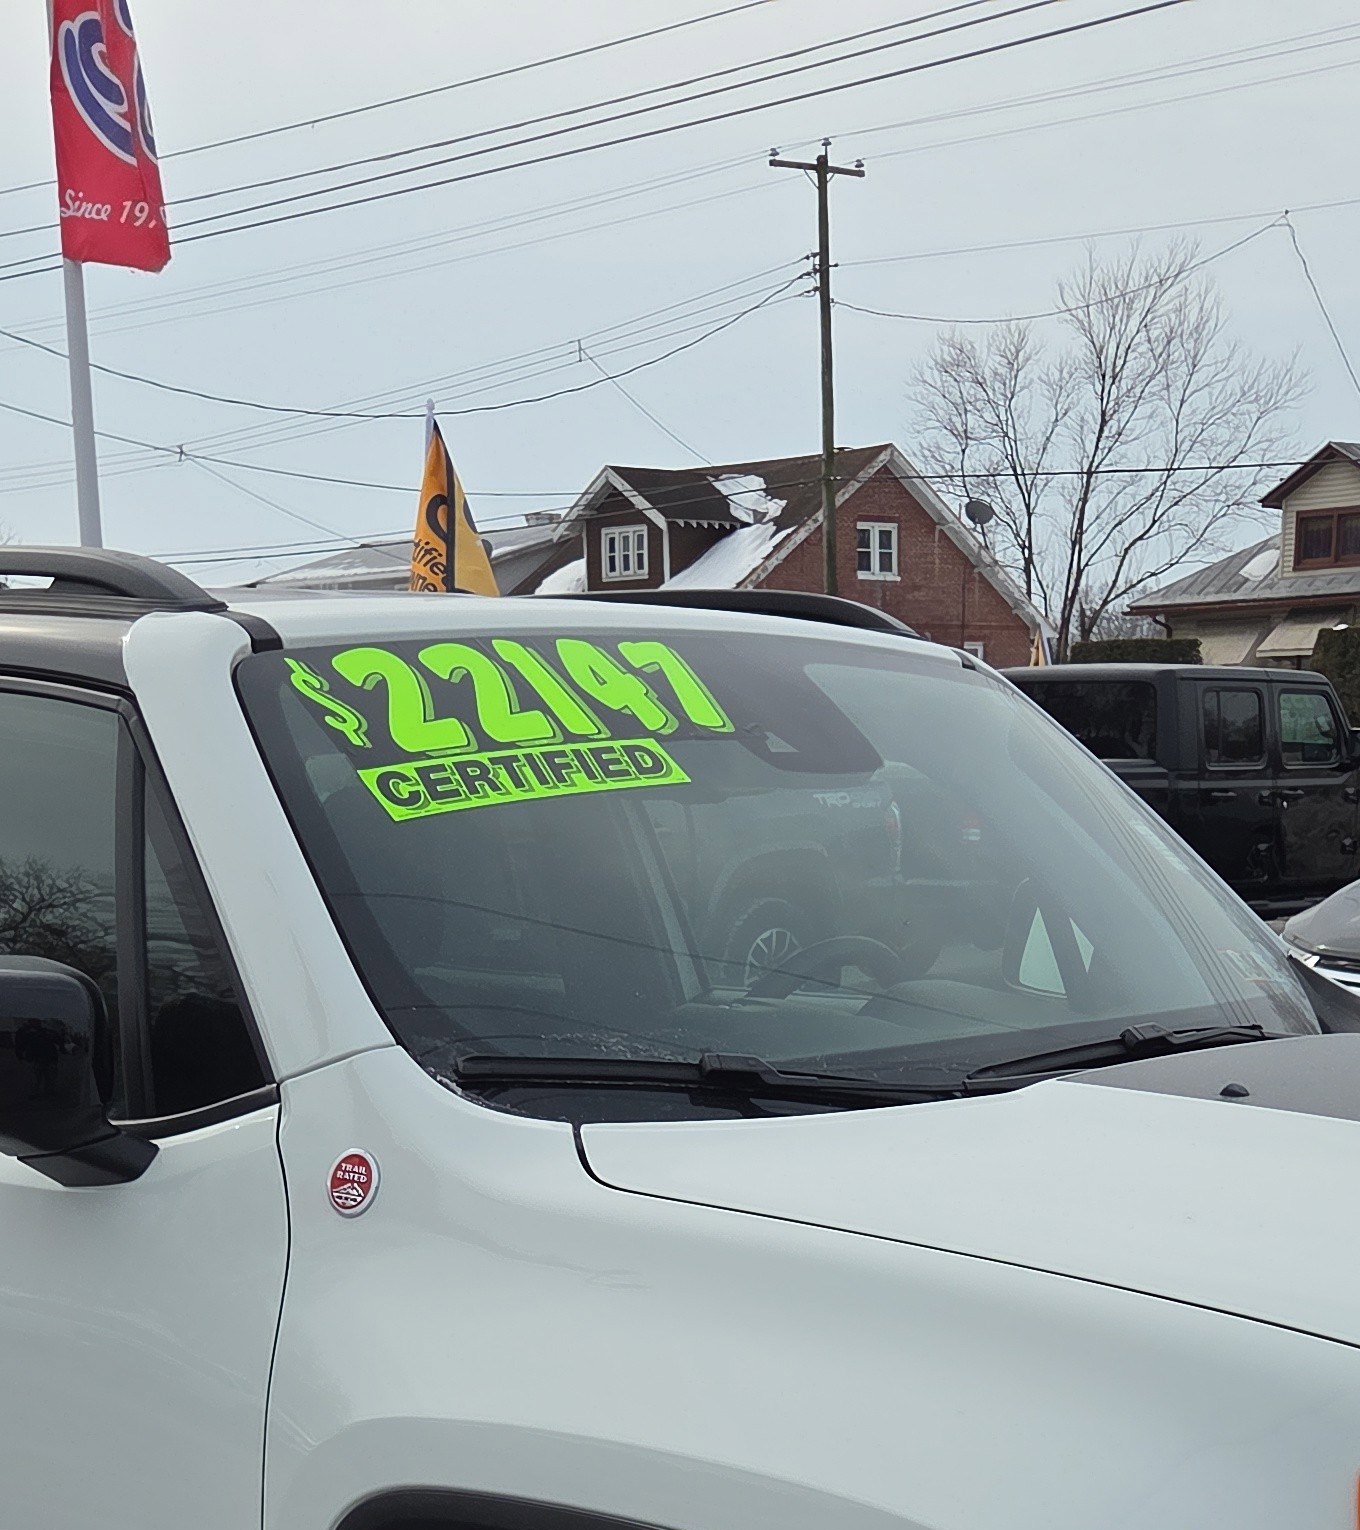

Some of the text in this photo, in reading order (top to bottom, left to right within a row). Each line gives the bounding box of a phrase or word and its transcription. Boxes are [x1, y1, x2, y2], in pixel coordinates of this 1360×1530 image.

[60, 189, 111, 221] Since
[284, 639, 734, 755] $22147
[375, 744, 667, 811] CERTIFIED
[336, 1171, 368, 1183] RATED
[341, 1163, 367, 1175] TRAIL
